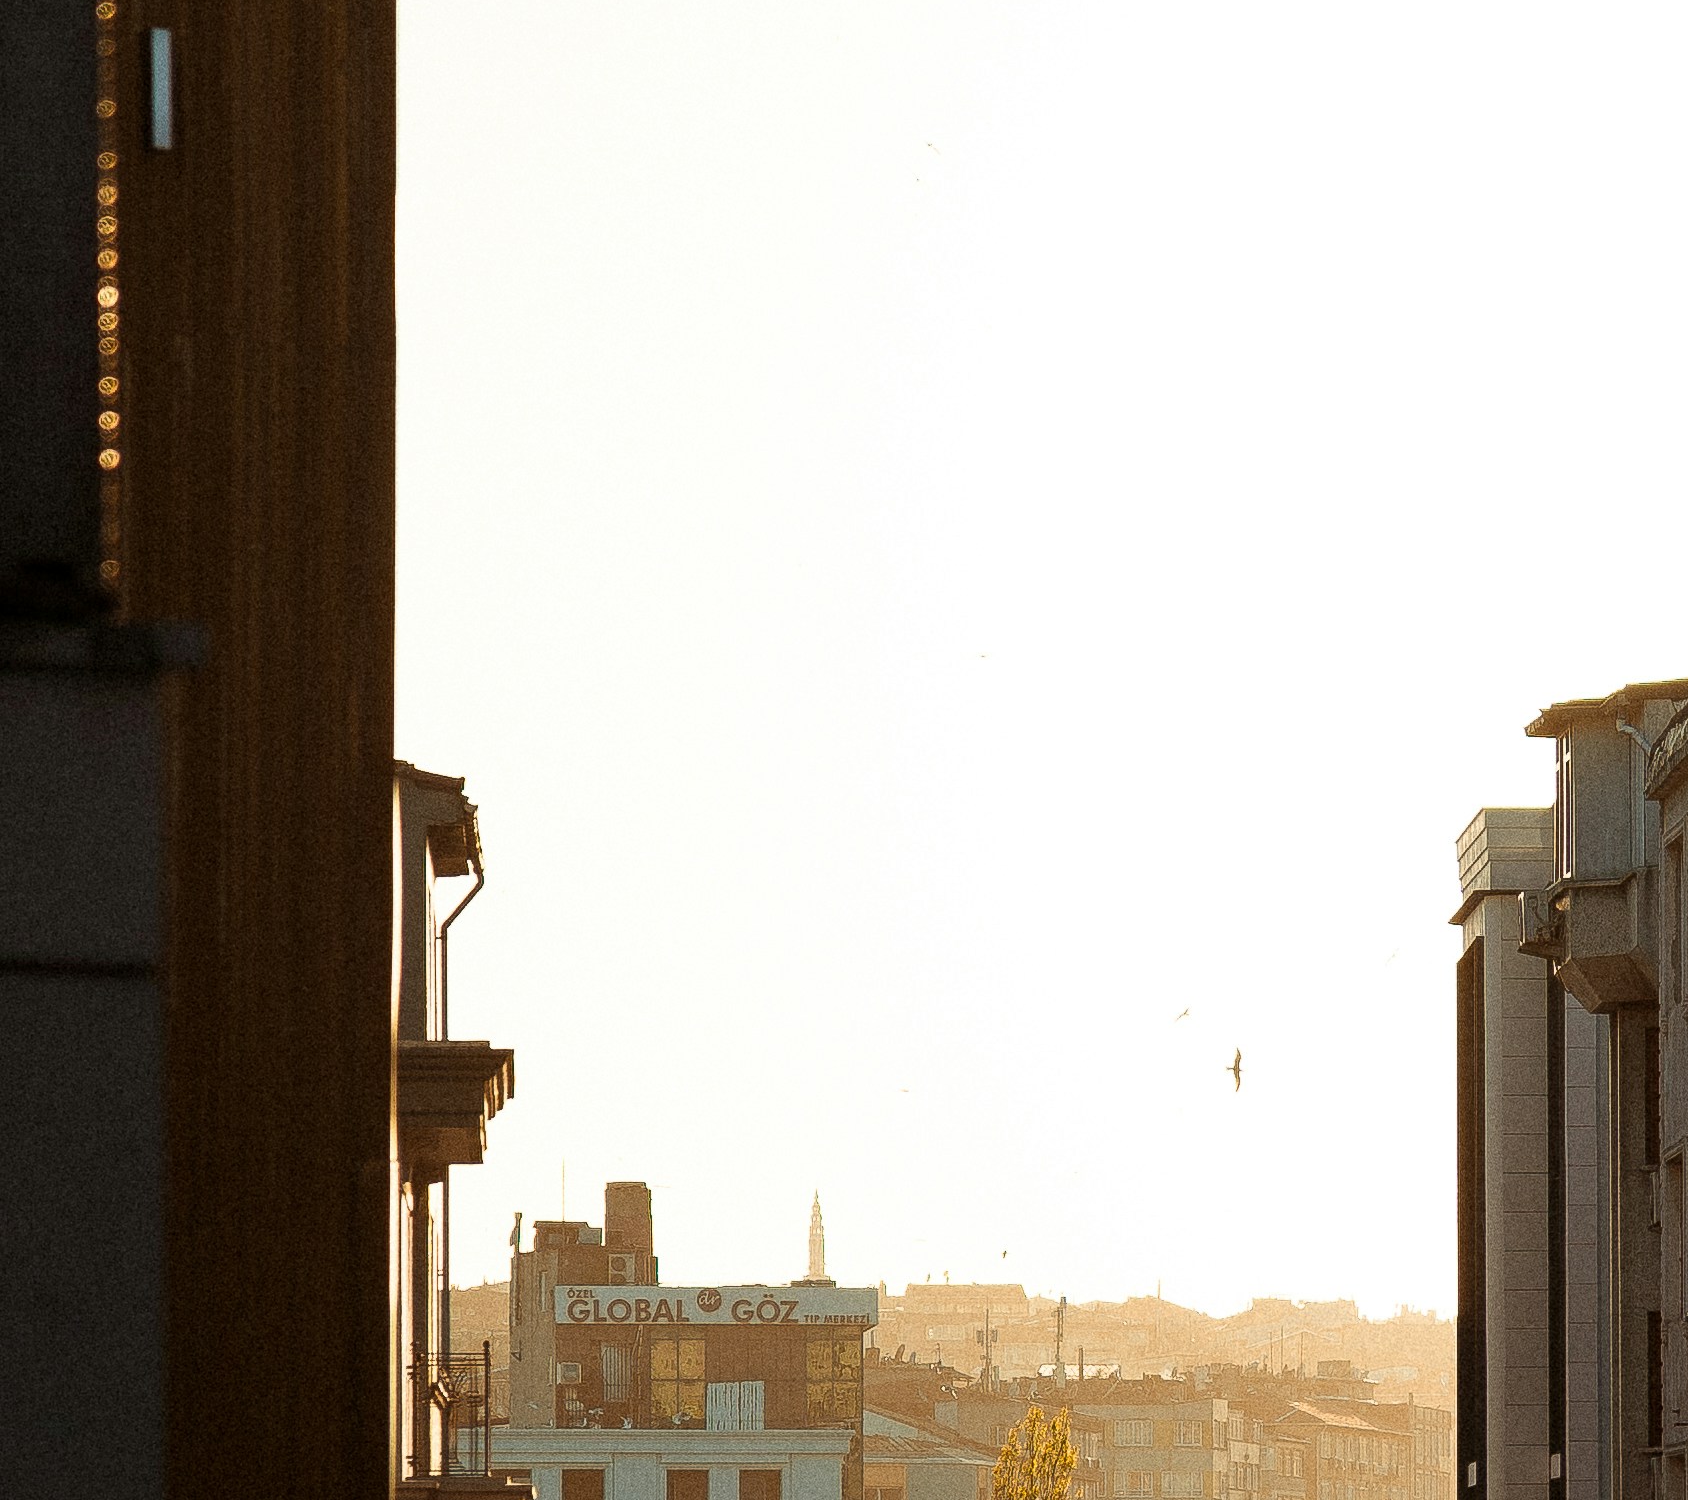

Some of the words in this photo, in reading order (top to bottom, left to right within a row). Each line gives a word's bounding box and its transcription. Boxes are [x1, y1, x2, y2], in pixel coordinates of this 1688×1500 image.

[567, 1287, 595, 1299] ÖZEL
[567, 1298, 690, 1323] GLOBAL
[731, 1293, 799, 1324] GÖZ
[804, 1314, 821, 1324] TIP
[824, 1313, 870, 1325] MERKEZİ
